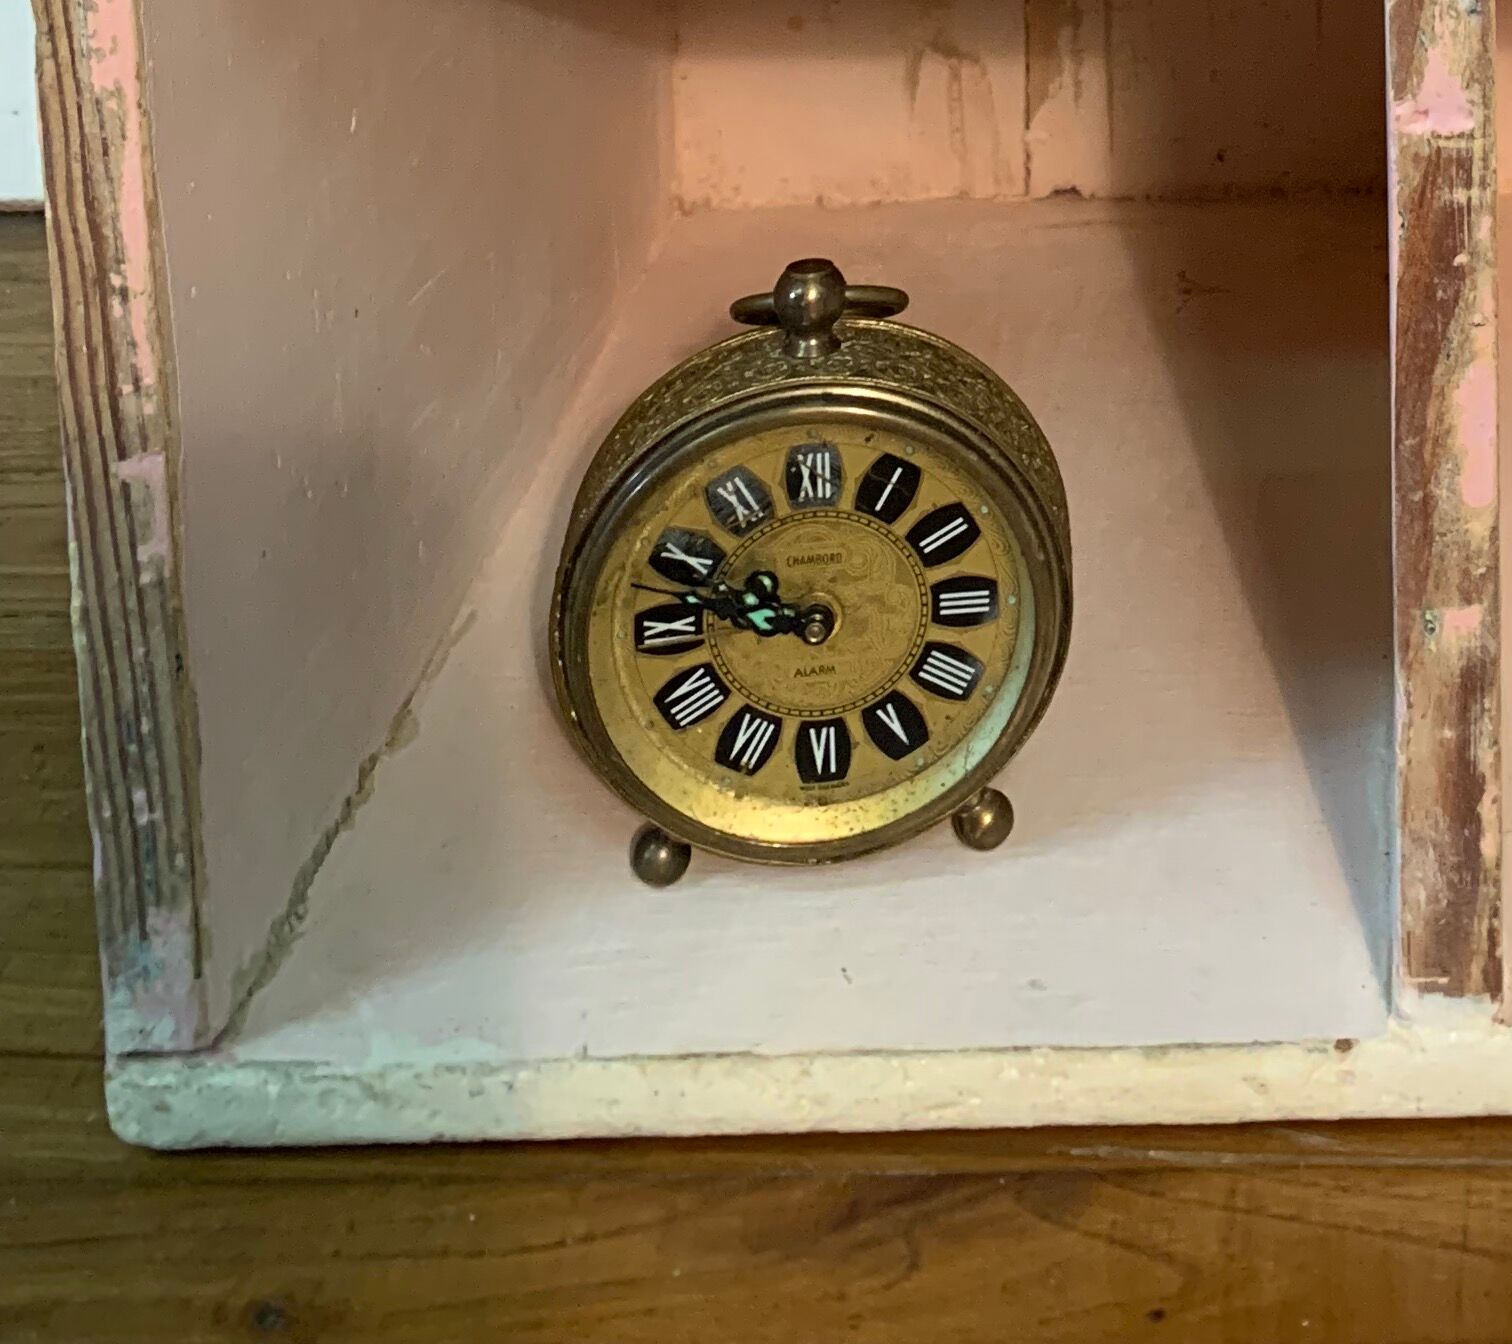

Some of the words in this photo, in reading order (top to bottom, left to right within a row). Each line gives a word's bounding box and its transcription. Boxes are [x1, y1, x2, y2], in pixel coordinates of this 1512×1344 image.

[797, 452, 831, 502] XII
[875, 467, 903, 511] I
[717, 477, 763, 528] XI
[919, 516, 968, 553] II
[661, 542, 713, 574] X
[786, 552, 842, 568] CHAMBORD
[939, 590, 990, 615] III
[643, 615, 695, 647] IX
[793, 664, 836, 678] ALARM
[918, 650, 975, 695] IIII
[664, 667, 724, 727] VIII
[729, 713, 775, 769] VII
[876, 703, 909, 746] V
[809, 726, 836, 775] VI
